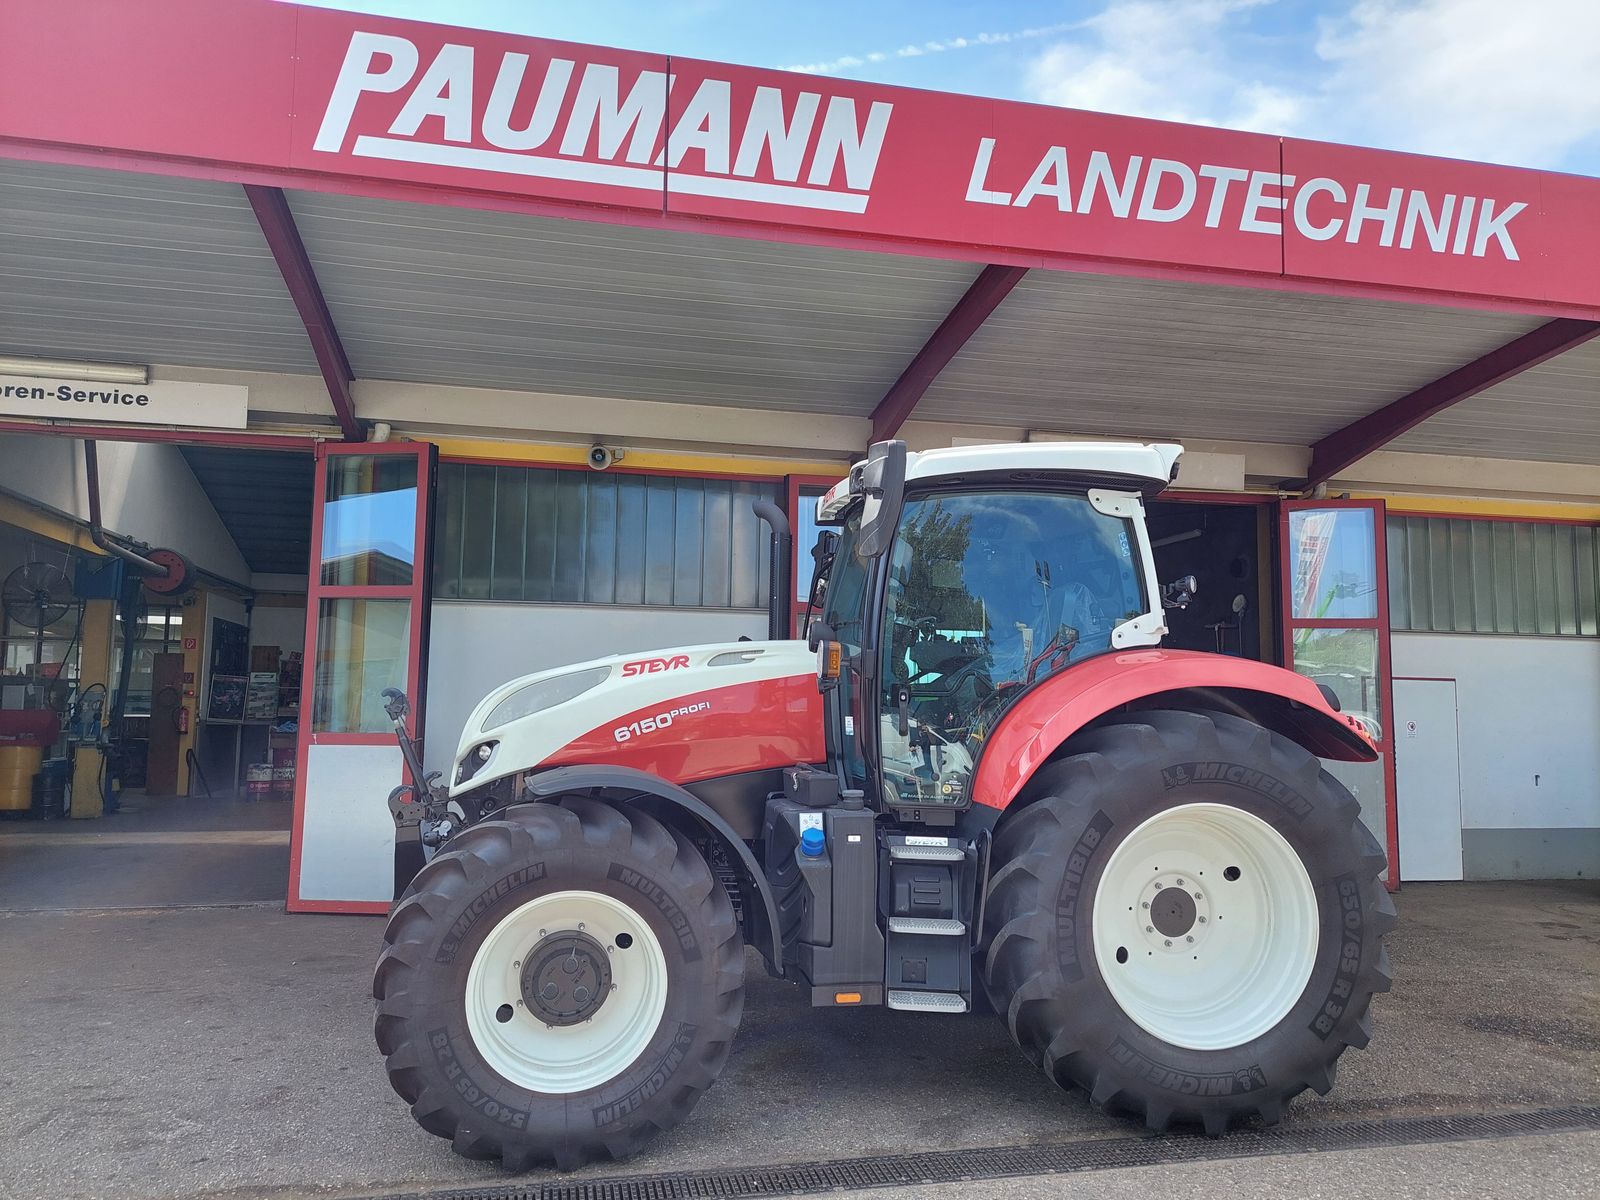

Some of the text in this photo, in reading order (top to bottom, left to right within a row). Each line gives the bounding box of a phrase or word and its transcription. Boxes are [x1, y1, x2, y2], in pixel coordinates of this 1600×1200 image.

[313, 31, 1528, 262] PAUMANN LANDTECHNIK
[0, 384, 149, 407] ren-Service
[621, 654, 690, 678] STEYR
[614, 701, 711, 743] 6150 PROFI
[1193, 761, 1314, 816] MICHELIN
[450, 862, 545, 941] MICHELIN
[620, 867, 696, 951] MULTIBIB
[1058, 827, 1101, 966] MULTIBIB
[1315, 878, 1362, 1034] 650/65 R 38
[432, 1031, 526, 1129] 540/65 R 28
[596, 1045, 684, 1128] MICHELIN
[1109, 1041, 1234, 1096] MICHELIN
